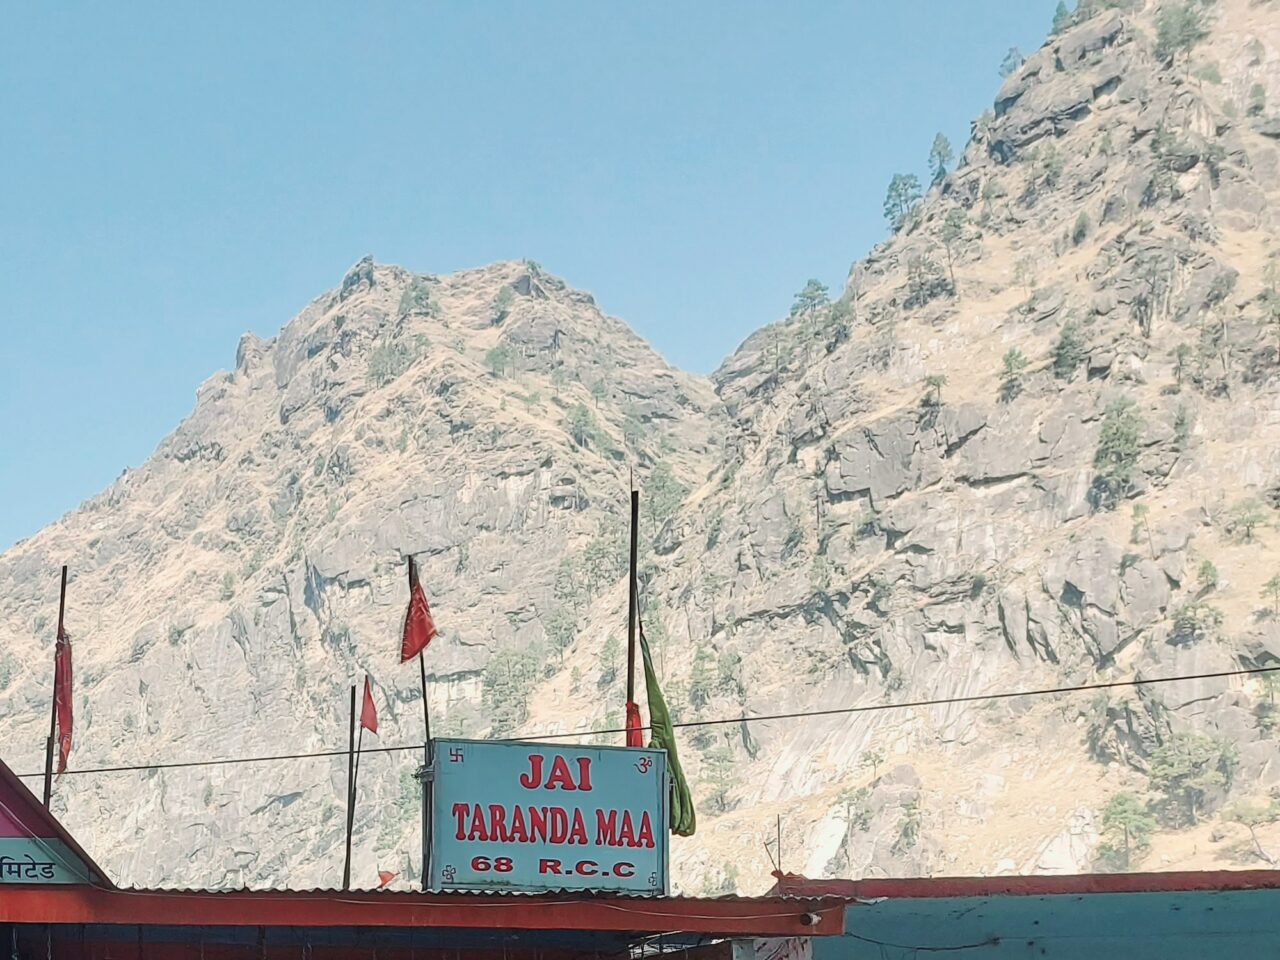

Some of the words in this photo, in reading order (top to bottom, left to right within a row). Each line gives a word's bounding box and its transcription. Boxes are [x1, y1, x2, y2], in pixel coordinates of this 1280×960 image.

[519, 754, 593, 791] JAI
[452, 803, 589, 845] TARANDA
[595, 808, 655, 848] MAA
[470, 855, 514, 873] 68
[538, 857, 636, 877] R.C.C
